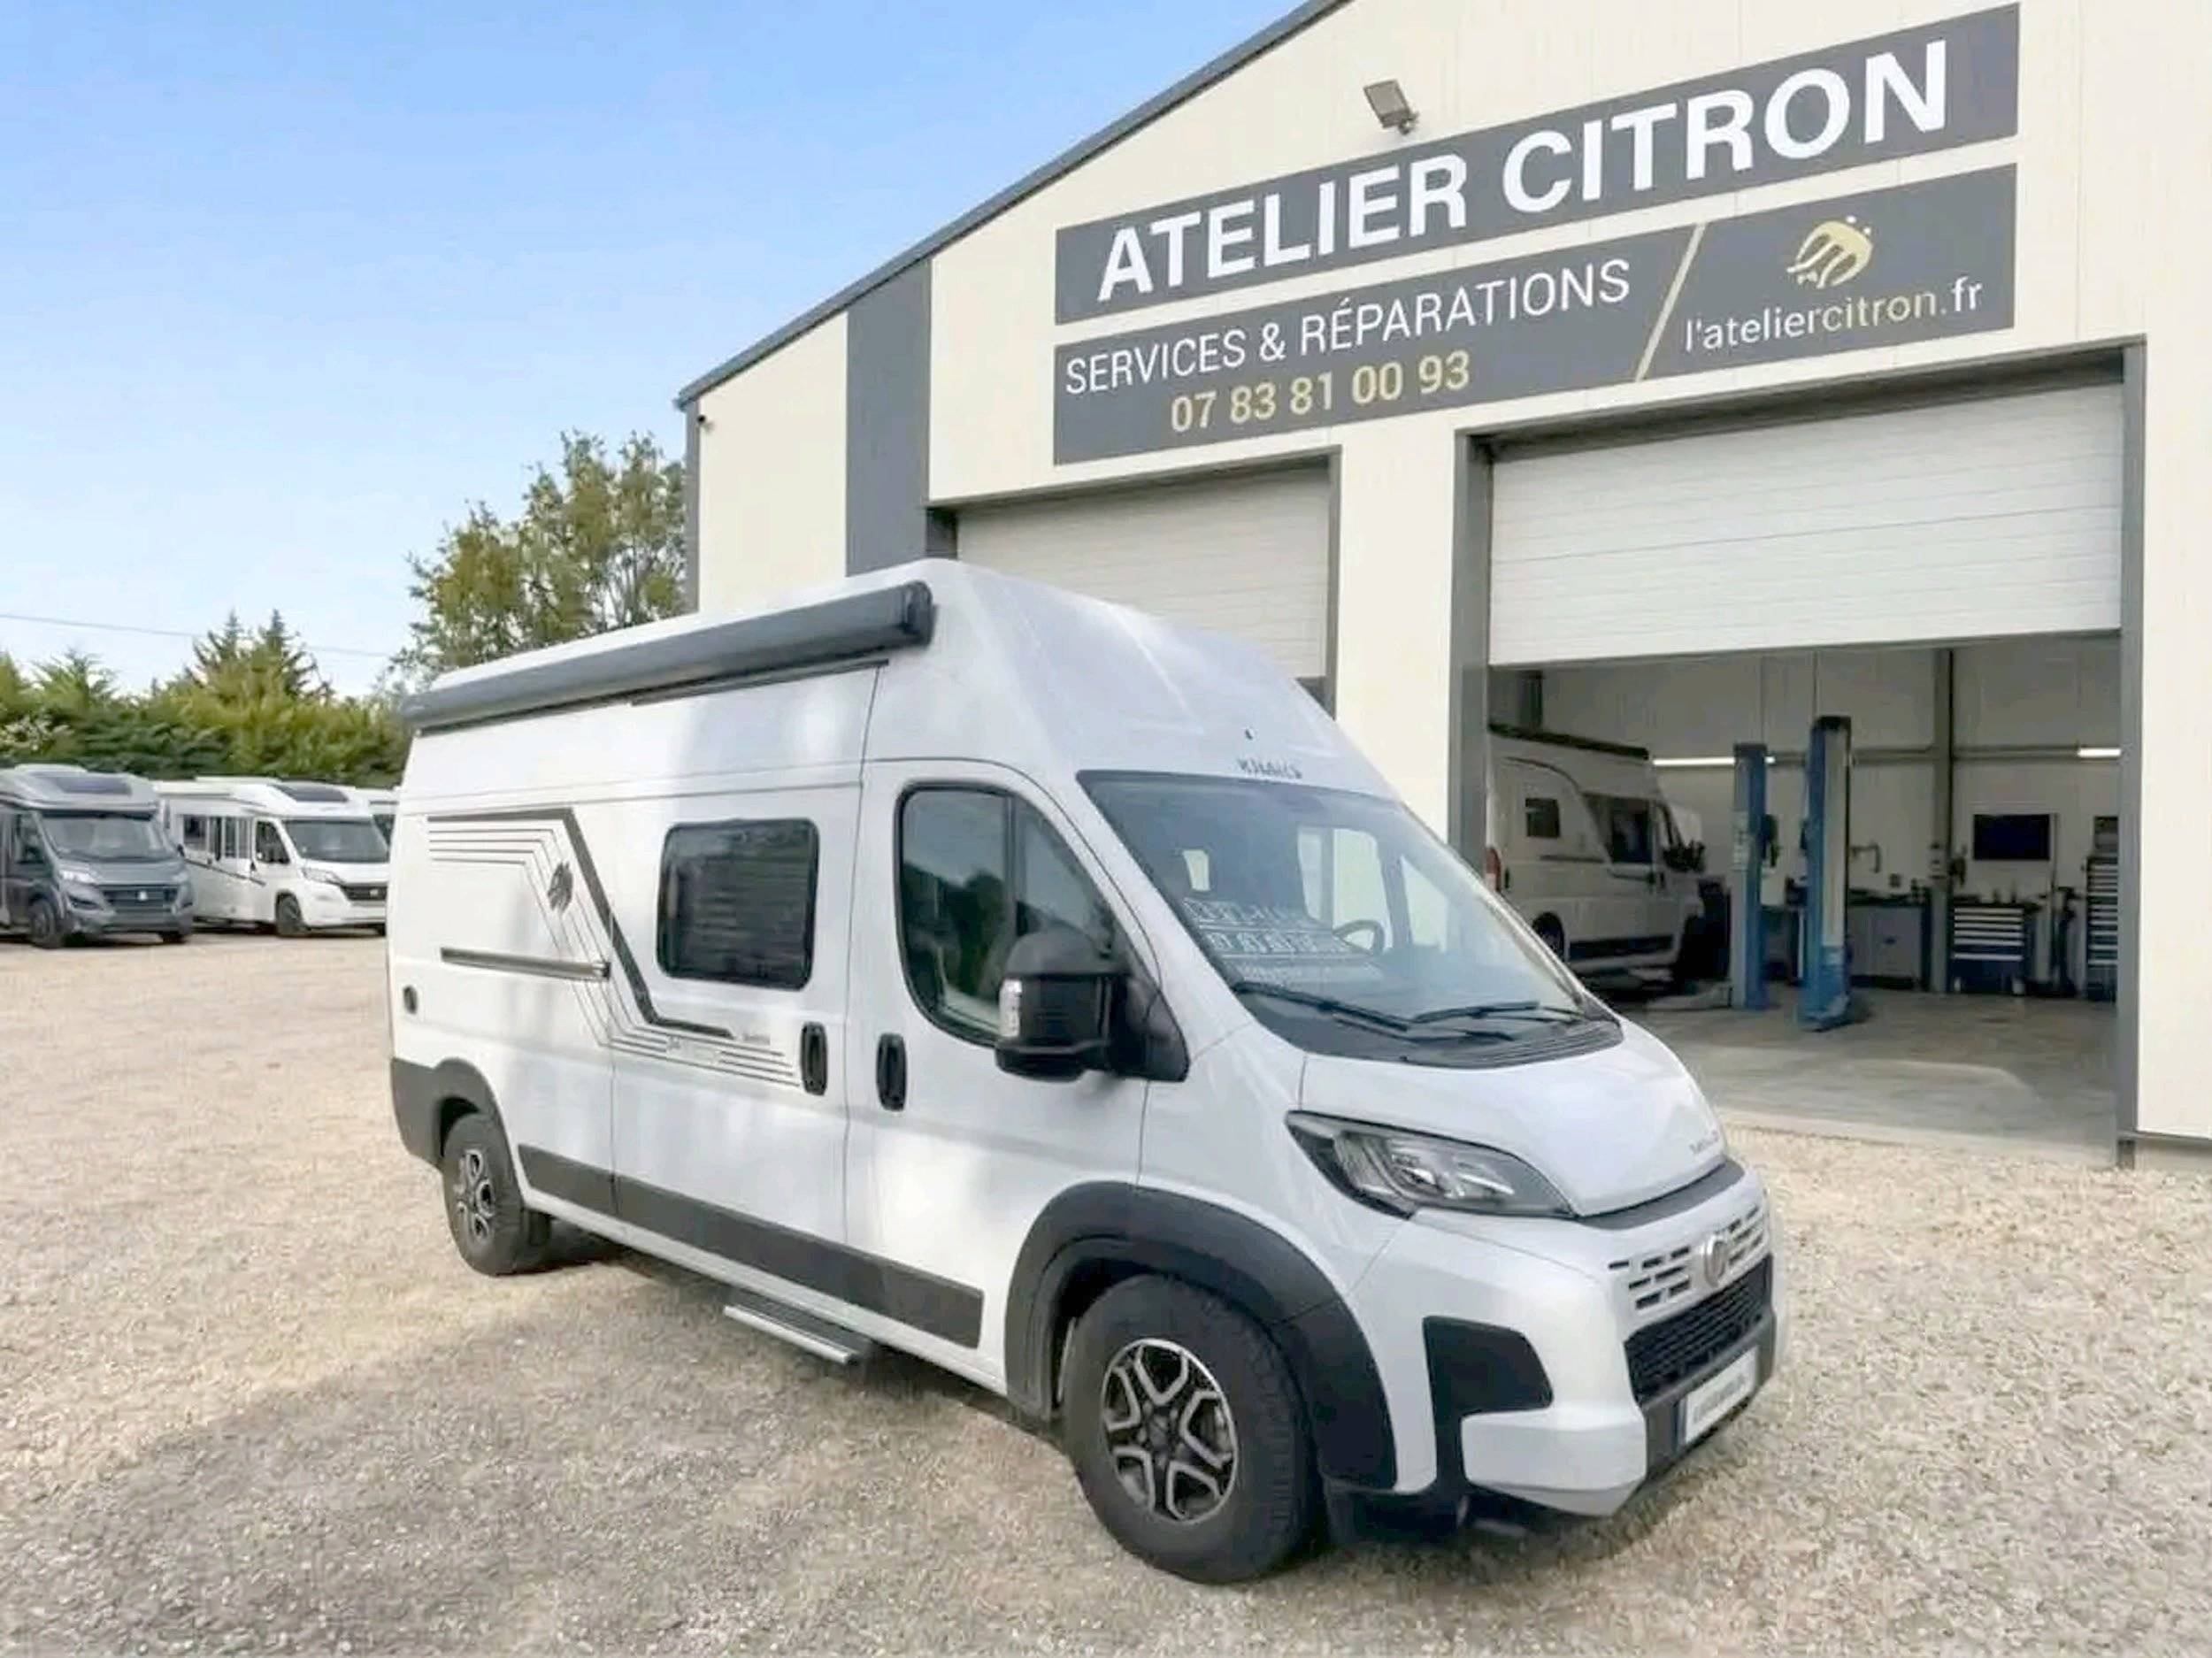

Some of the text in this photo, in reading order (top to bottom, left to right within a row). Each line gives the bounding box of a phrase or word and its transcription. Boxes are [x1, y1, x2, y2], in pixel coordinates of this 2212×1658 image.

[1097, 39, 1947, 303] ATELIER CITRON
[1065, 257, 1631, 395] SERVICES & RÉPARATIONS
[1685, 275, 1984, 352] l'ateliercitron.fr
[1171, 350, 1471, 434] 07 83 81 00 93
